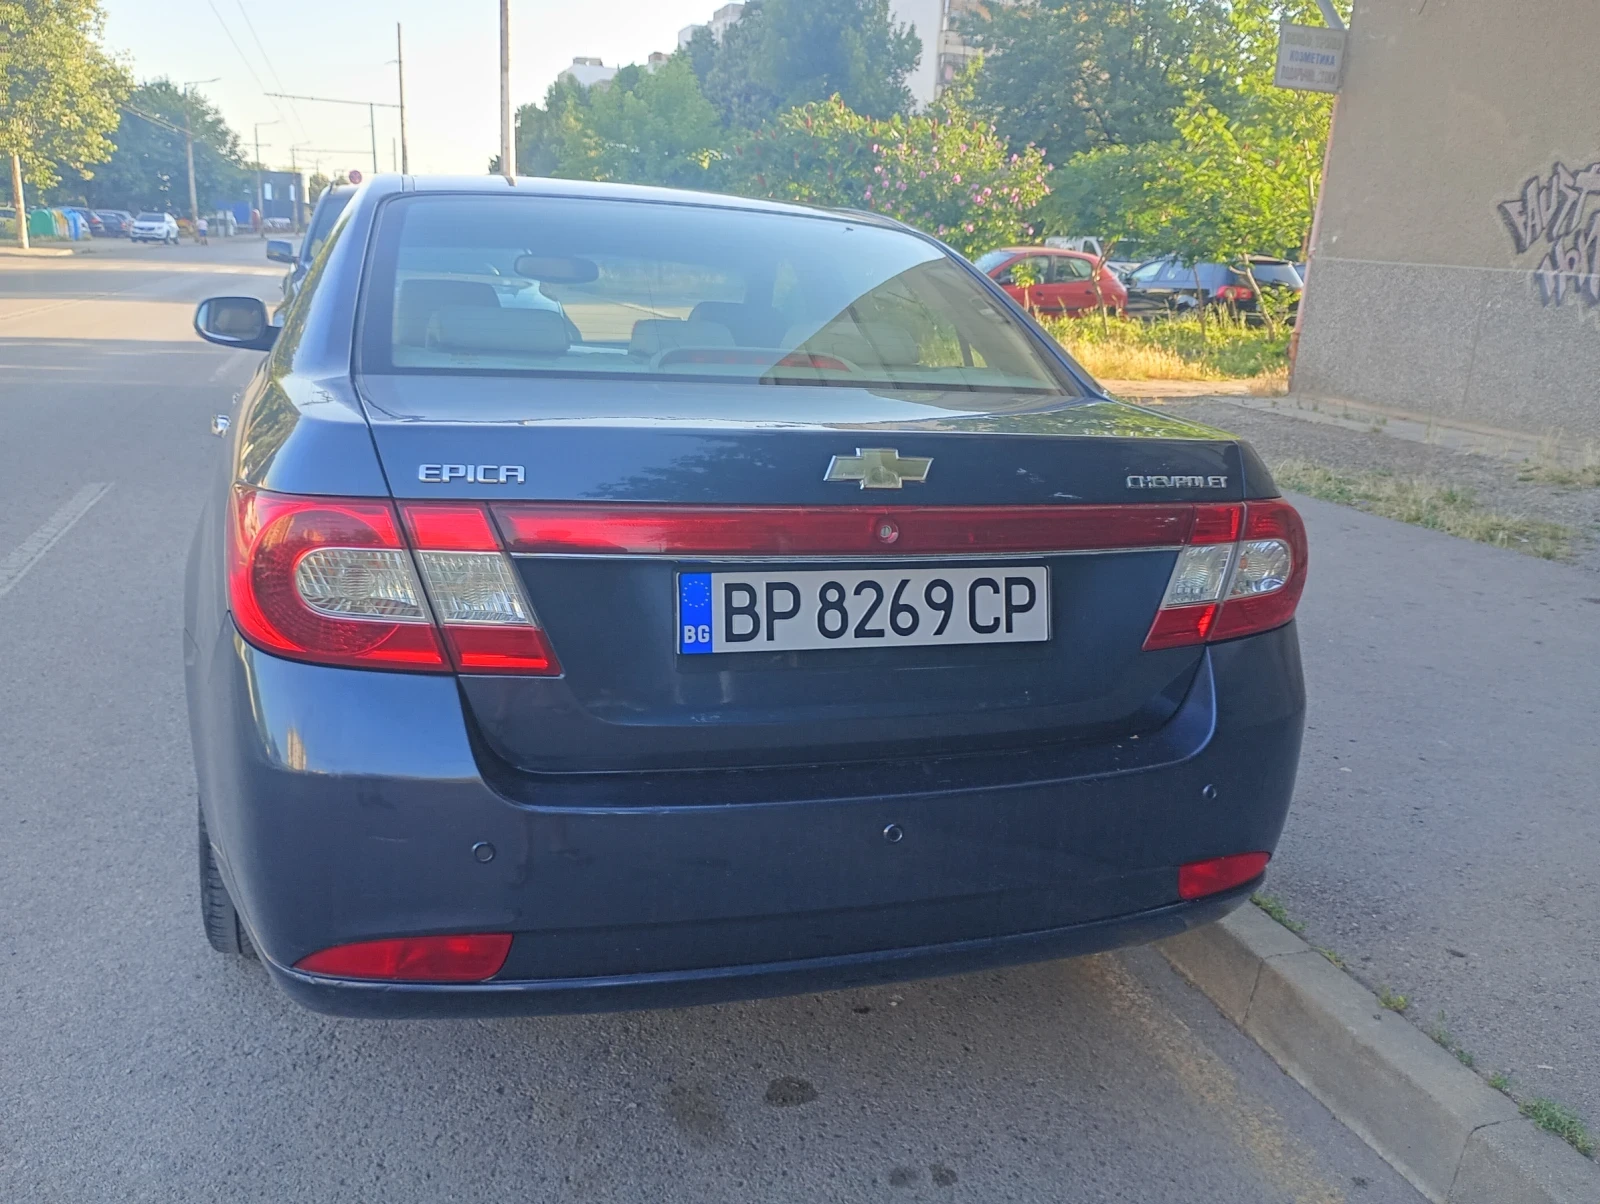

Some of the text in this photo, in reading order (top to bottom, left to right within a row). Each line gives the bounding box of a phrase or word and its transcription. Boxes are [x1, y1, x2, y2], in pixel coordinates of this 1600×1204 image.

[418, 464, 525, 484] EPICA
[1126, 475, 1228, 489] CHEVROLET
[724, 576, 1037, 643] BP 8269 CP
[683, 625, 710, 644] BG
